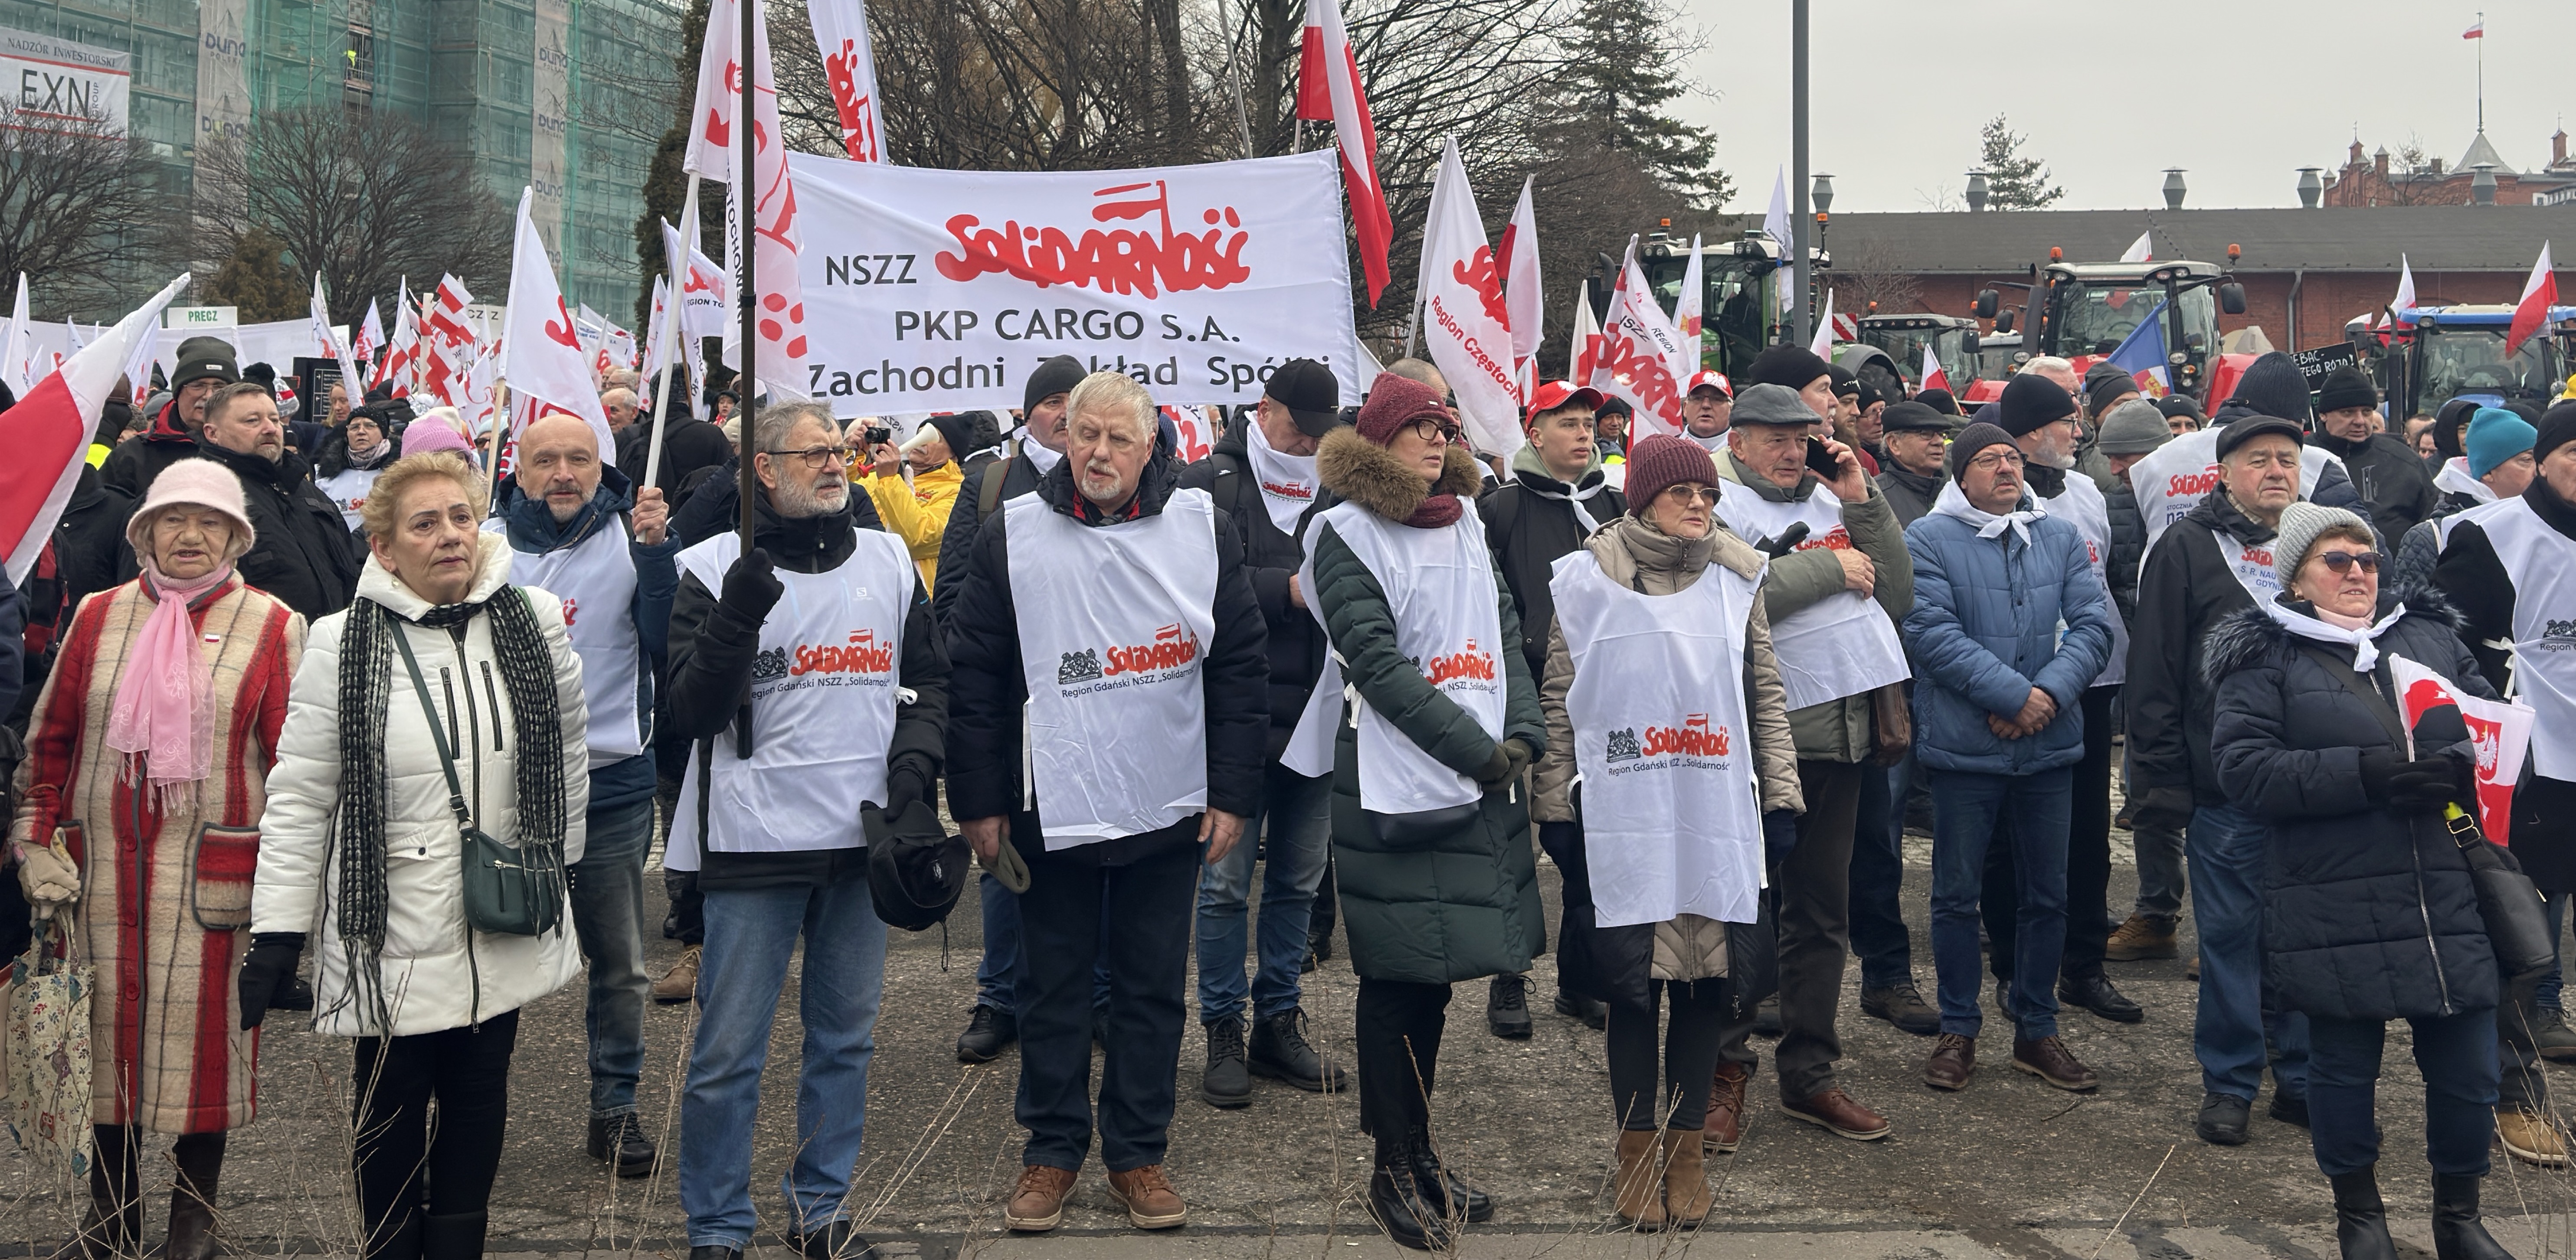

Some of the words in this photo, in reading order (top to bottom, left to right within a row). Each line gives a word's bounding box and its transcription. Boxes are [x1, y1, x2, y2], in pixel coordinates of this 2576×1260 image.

[8, 37, 49, 55] NADZÓR
[54, 46, 115, 67] INWESTORSKI
[22, 69, 90, 118] EXN
[92, 82, 100, 119] GROUP
[826, 255, 917, 285] NSZZ
[188, 310, 218, 322] PRECZ
[491, 311, 498, 320] Z
[895, 310, 978, 340] PKP
[995, 309, 1144, 340] CARGO
[1162, 314, 1240, 342] S.A.
[1431, 295, 1464, 341] Region
[1464, 337, 1519, 407] Częstoch
[1651, 328, 1677, 353] REGION
[808, 356, 1004, 397] Zachodni
[1037, 355, 1178, 385] kład
[1207, 356, 1329, 392] Spói
[2300, 363, 2321, 376] ZEGO
[2167, 512, 2190, 525] na
[2250, 568, 2257, 576] R.
[2540, 643, 2571, 652] Region
[752, 686, 775, 700] egion
[778, 678, 814, 692] Gdański
[818, 677, 841, 687] NSZZ
[1062, 686, 1092, 698] Region
[1094, 678, 1130, 692] Gdański
[1133, 675, 1155, 685] NSZZ
[1448, 681, 1467, 691] NSZZ
[1608, 766, 1630, 776] Region
[1633, 760, 1667, 771] Gdański
